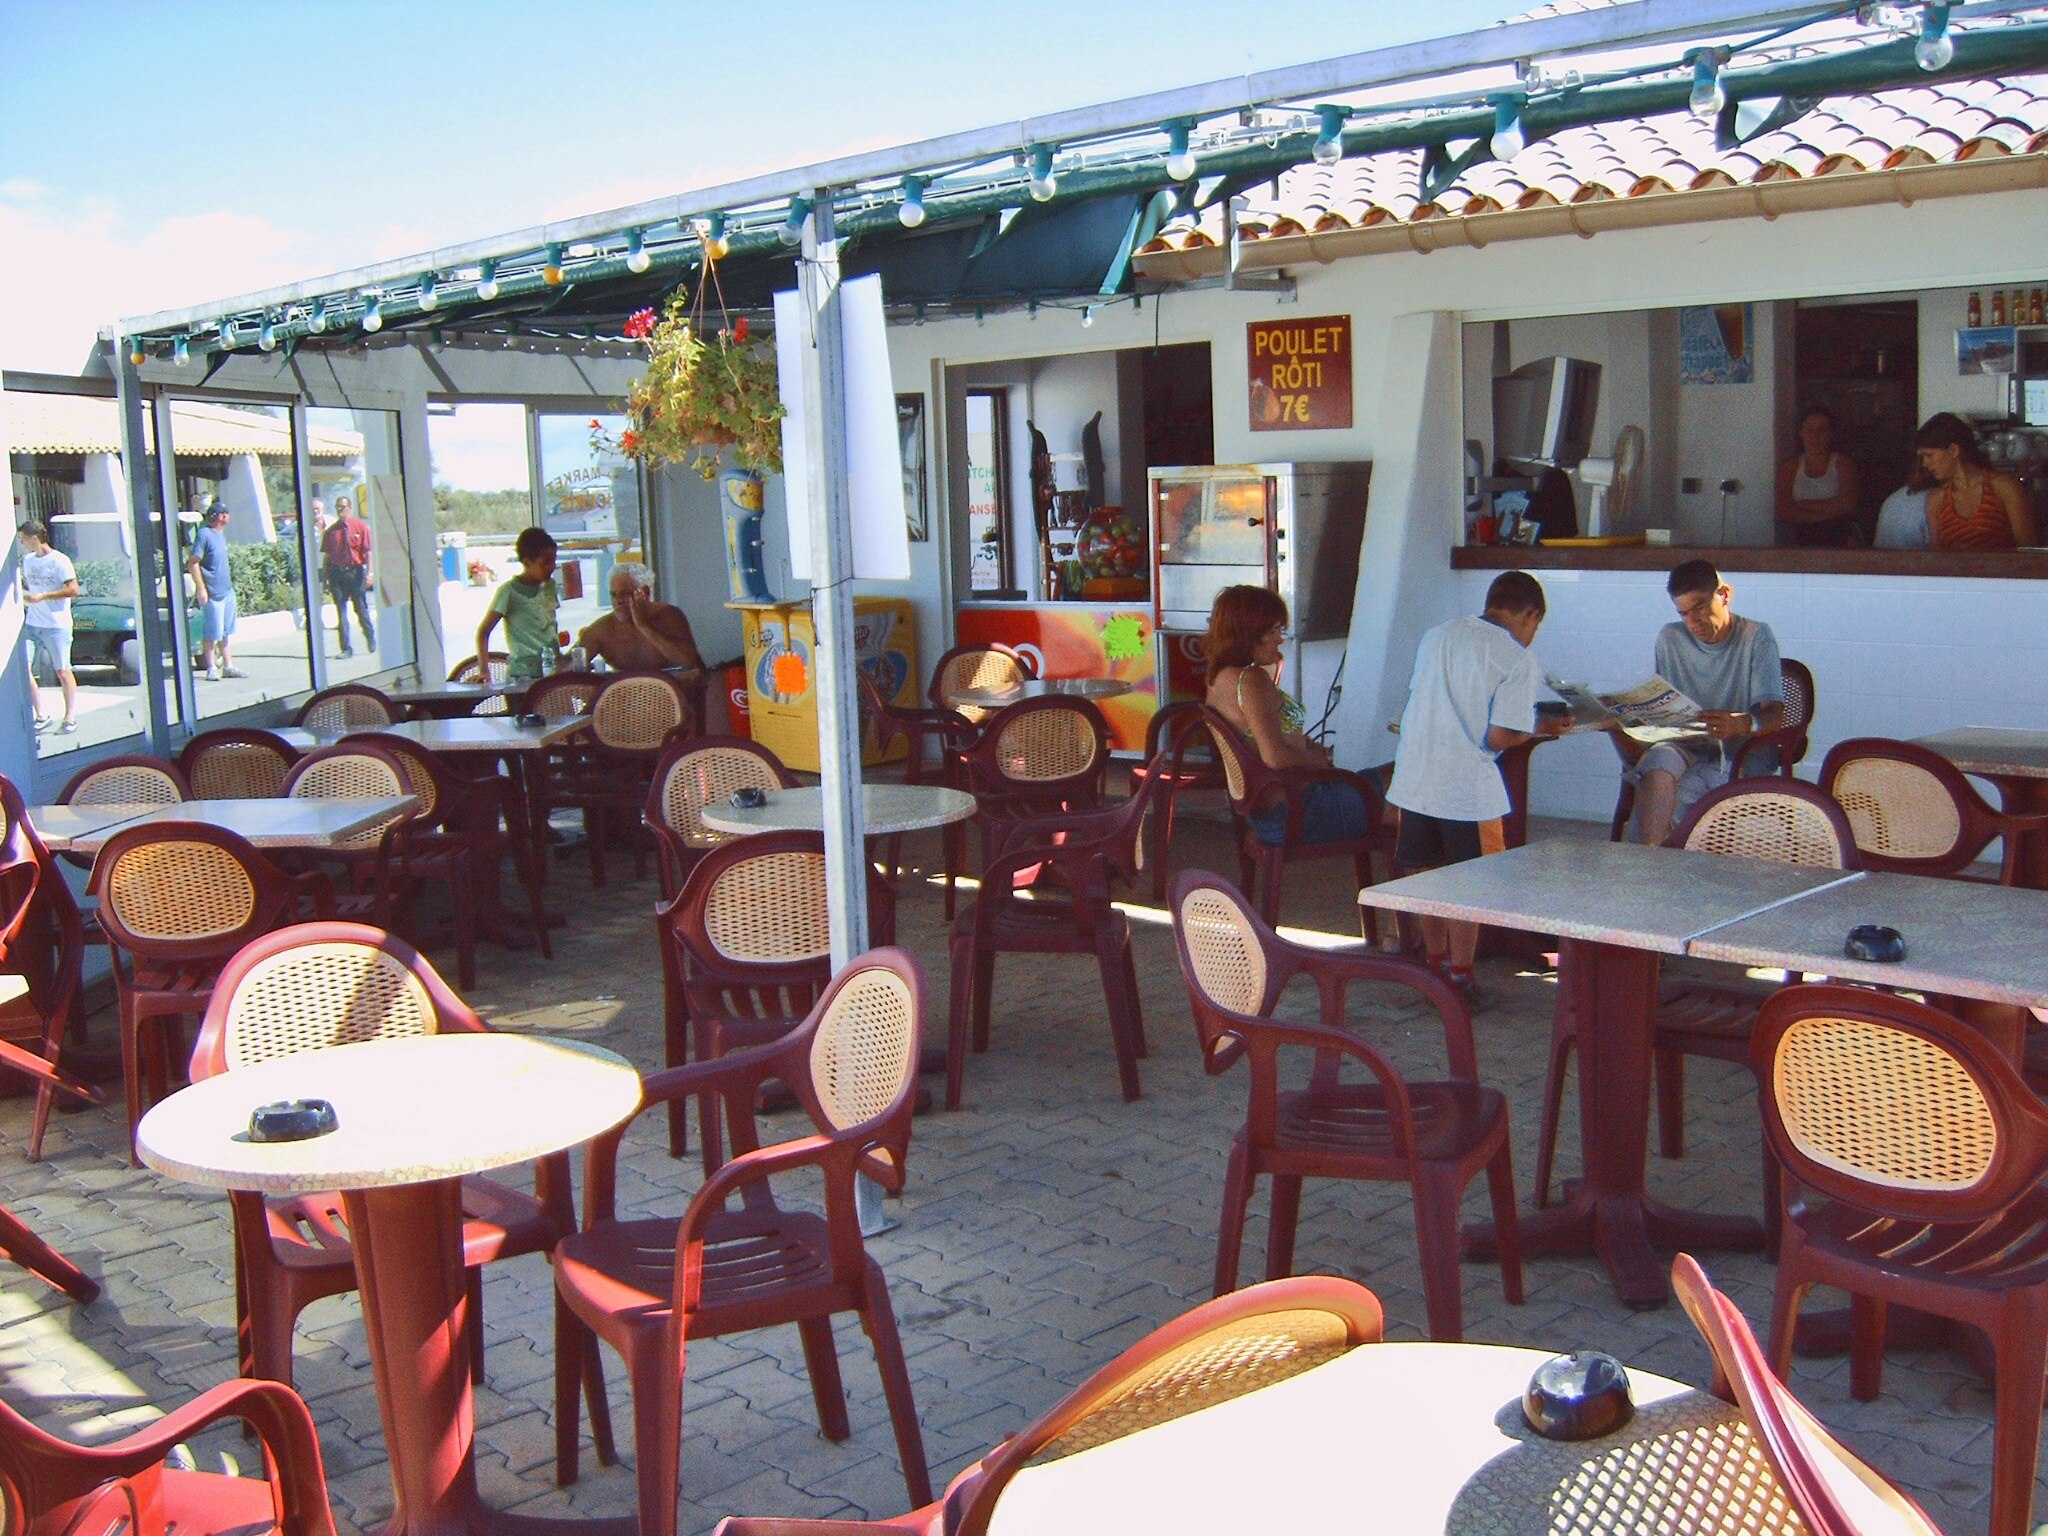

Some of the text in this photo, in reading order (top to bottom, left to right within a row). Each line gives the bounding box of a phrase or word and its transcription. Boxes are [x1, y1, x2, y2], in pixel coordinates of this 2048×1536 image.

[1255, 327, 1343, 356] POULET
[1272, 355, 1321, 389] RÔTI
[1280, 394, 1311, 422] 7€
